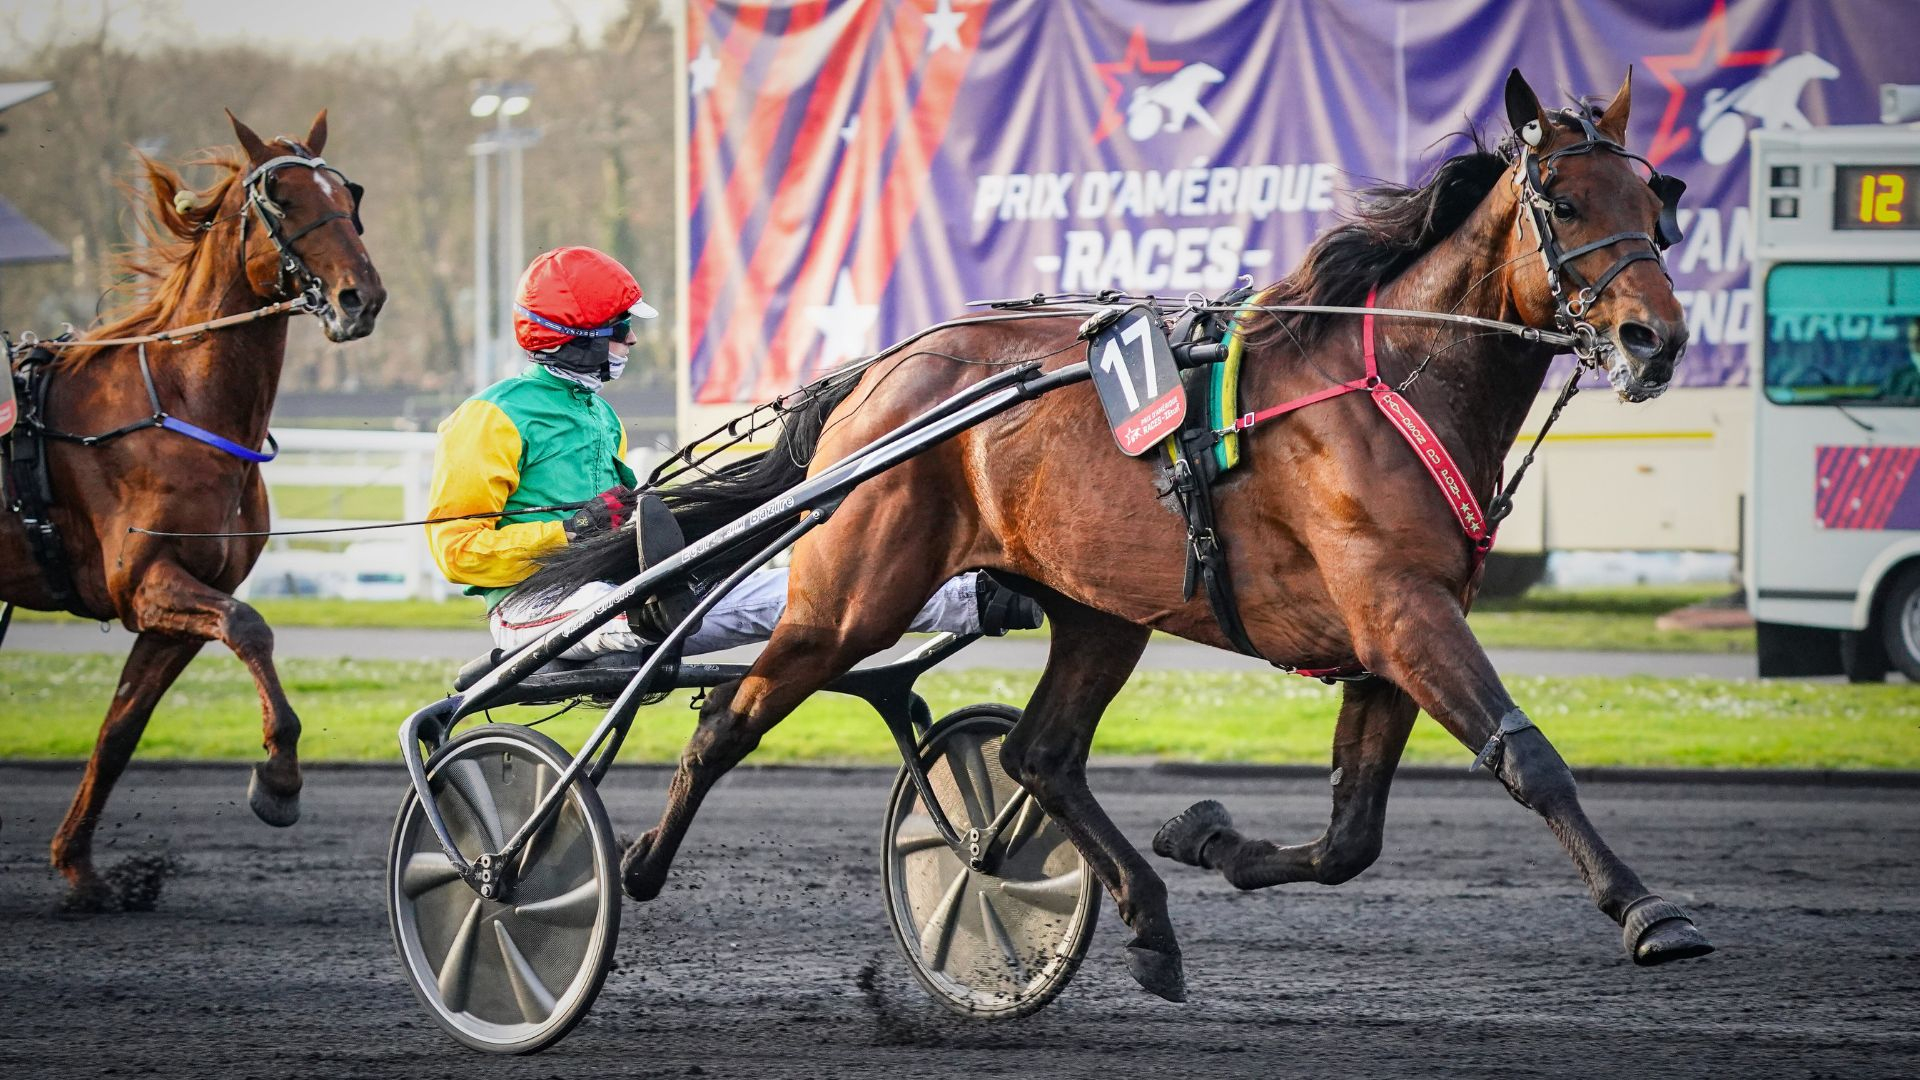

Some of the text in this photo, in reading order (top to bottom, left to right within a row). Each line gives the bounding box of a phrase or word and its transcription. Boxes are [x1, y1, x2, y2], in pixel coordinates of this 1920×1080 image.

[974, 158, 1336, 222] PRIX D'AMÉRIQUE
[1860, 174, 1905, 223] 12
[1100, 315, 1158, 412] 17
[1426, 449, 1441, 465] DU
[1441, 469, 1462, 500] PONT
[750, 495, 795, 525] Bazire
